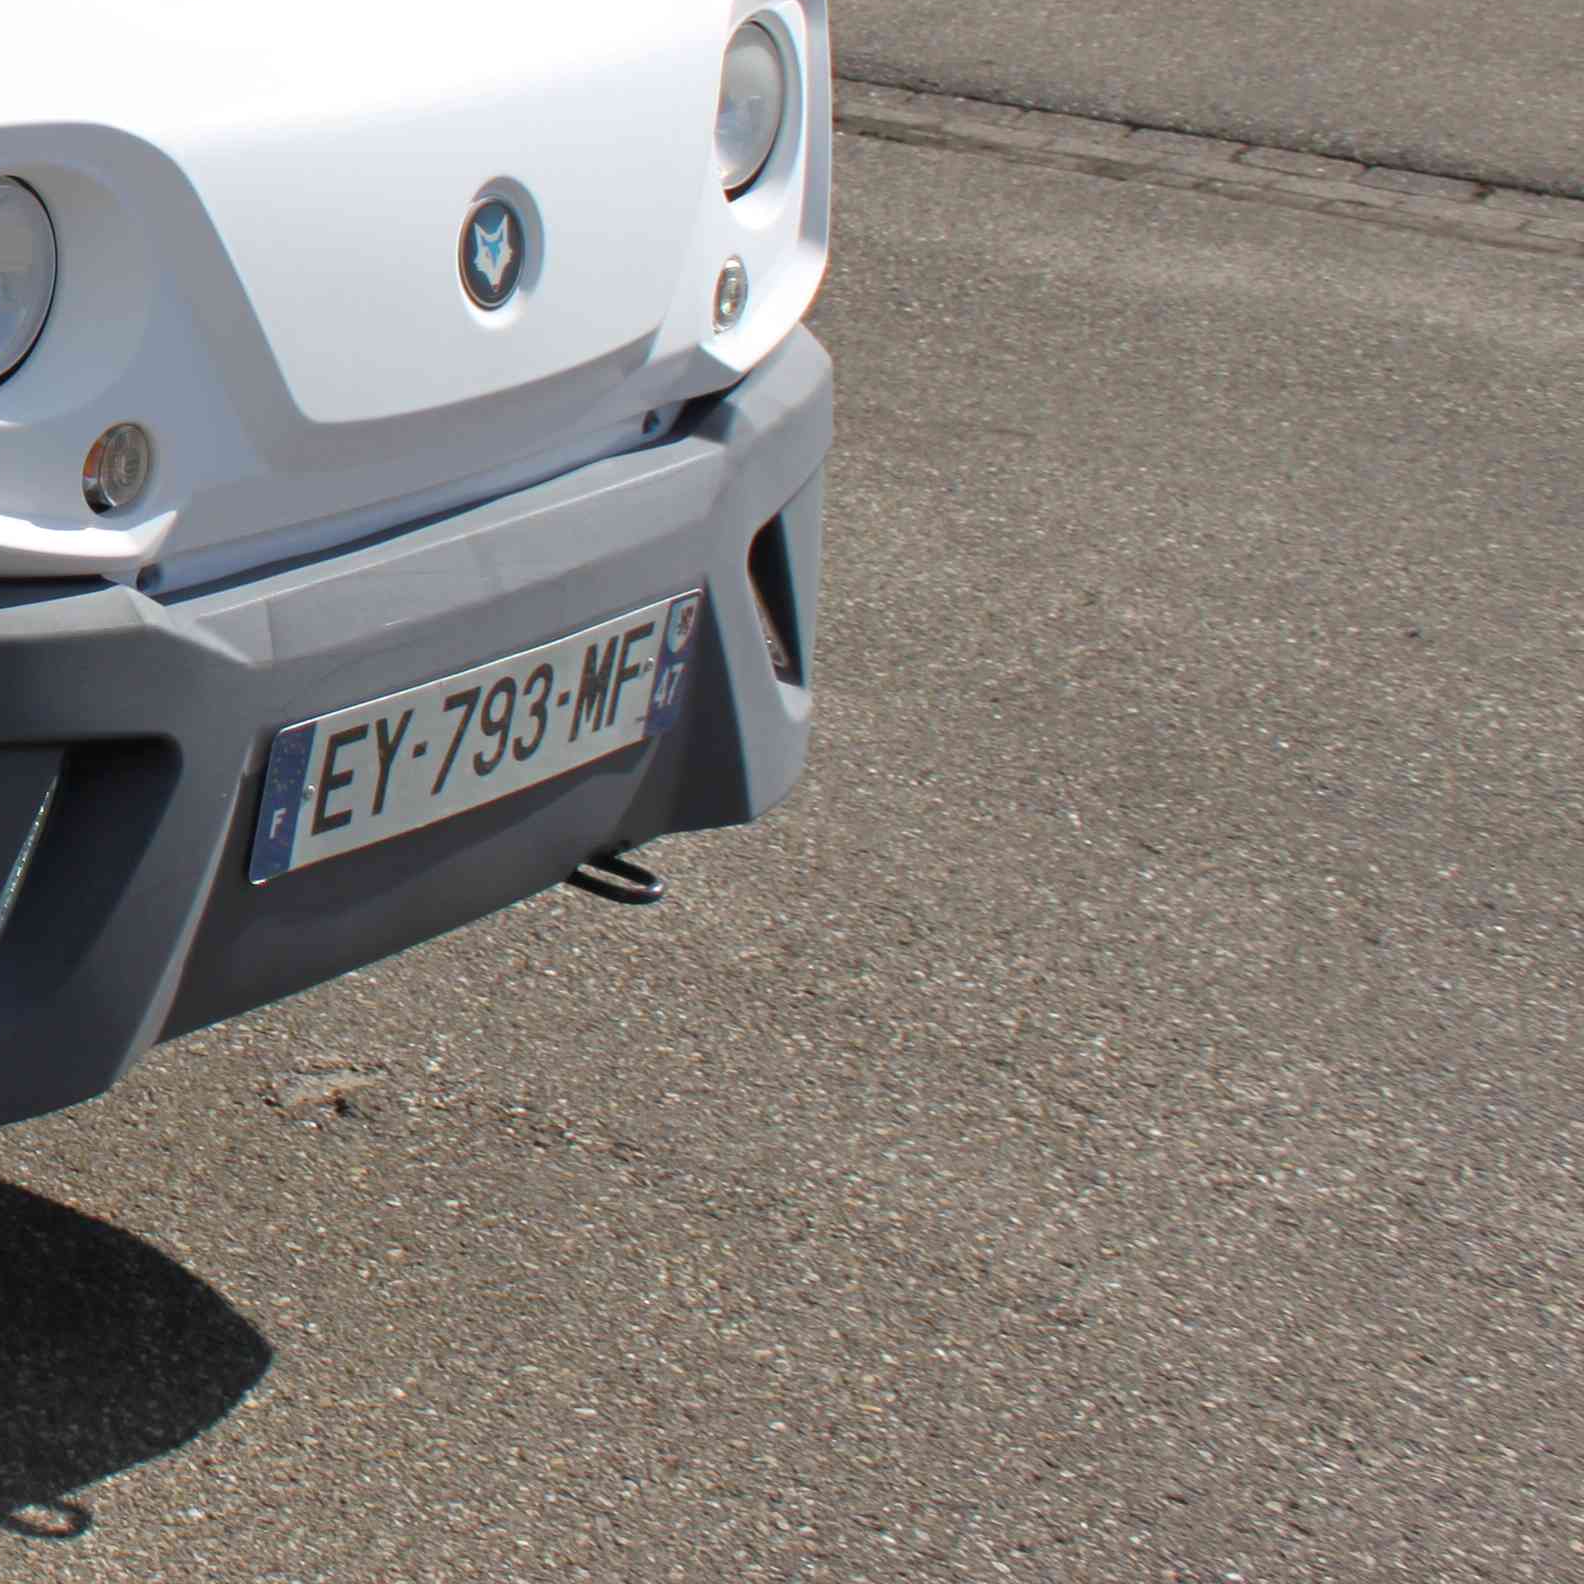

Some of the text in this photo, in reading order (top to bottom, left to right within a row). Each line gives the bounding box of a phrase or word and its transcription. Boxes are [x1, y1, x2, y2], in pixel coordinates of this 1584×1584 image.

[653, 662, 688, 709] 47
[310, 620, 655, 836] EY-793-MF
[269, 807, 287, 839] F
